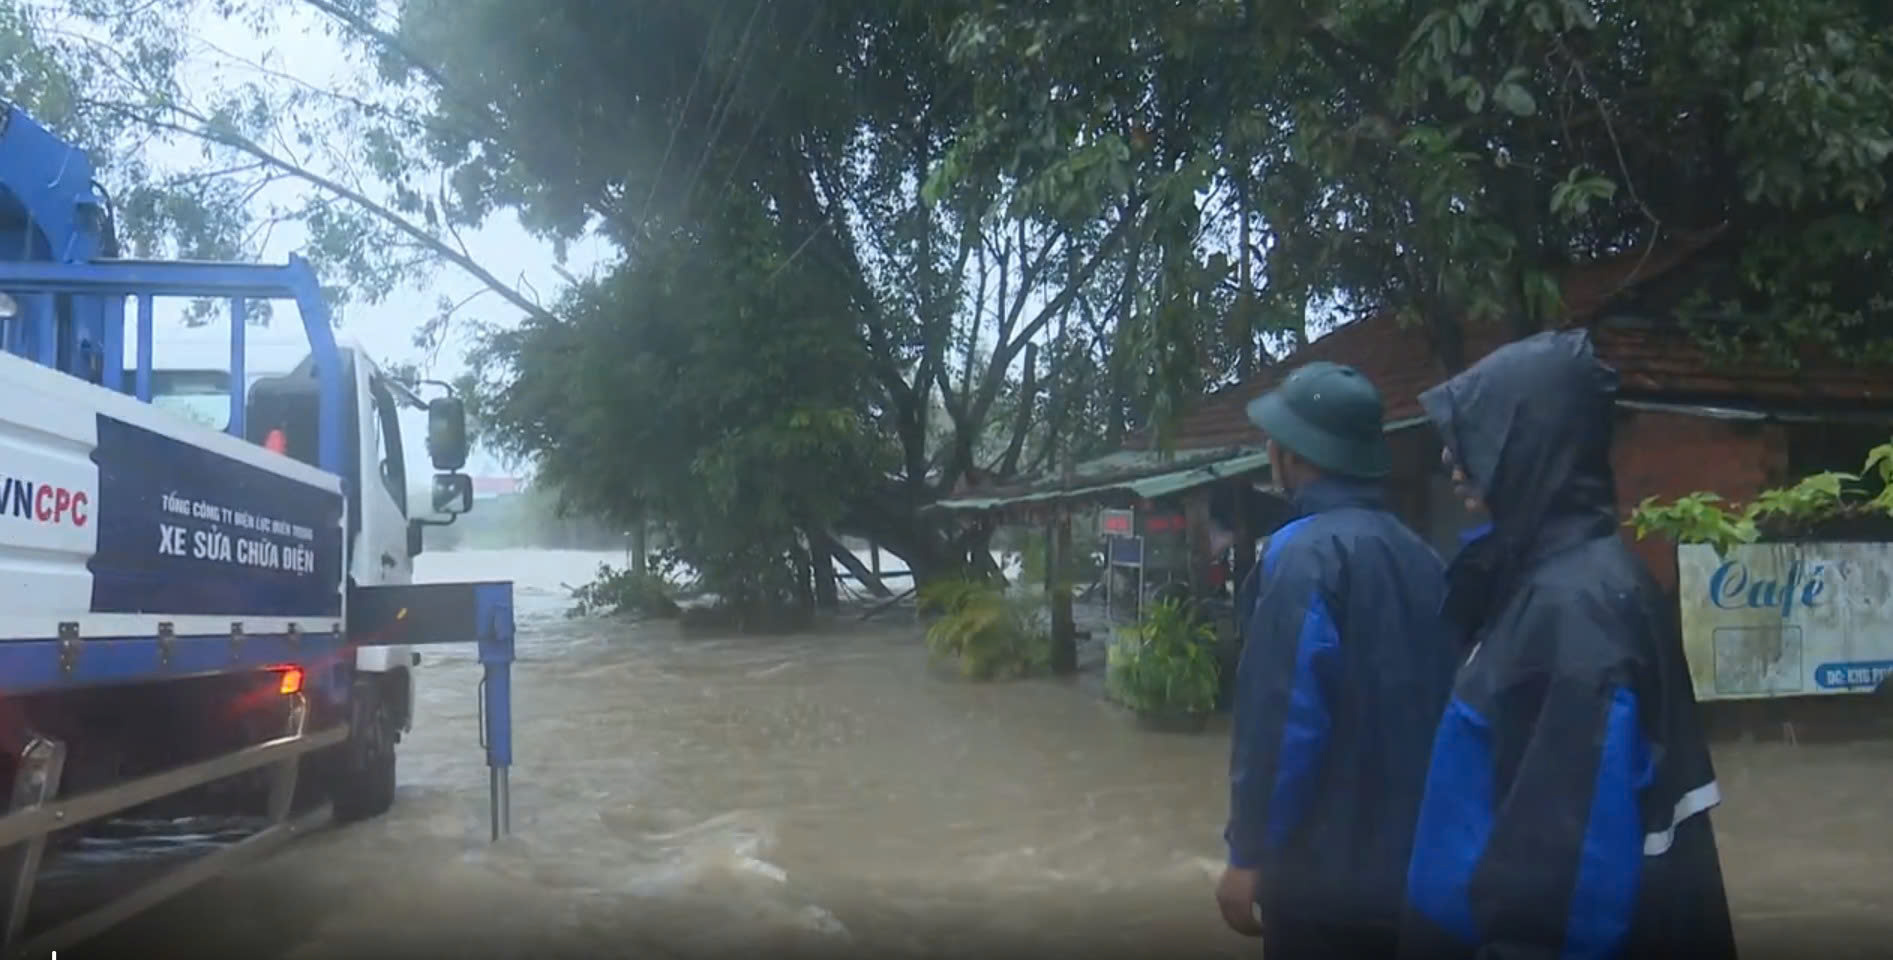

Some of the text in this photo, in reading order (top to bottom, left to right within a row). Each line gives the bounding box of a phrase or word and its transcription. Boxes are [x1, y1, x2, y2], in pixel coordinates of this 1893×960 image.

[222, 507, 232, 524] TY
[159, 523, 187, 556] XE
[193, 524, 232, 562] SỬA
[236, 537, 280, 569] CHỮA
[1709, 559, 1825, 618] Café
